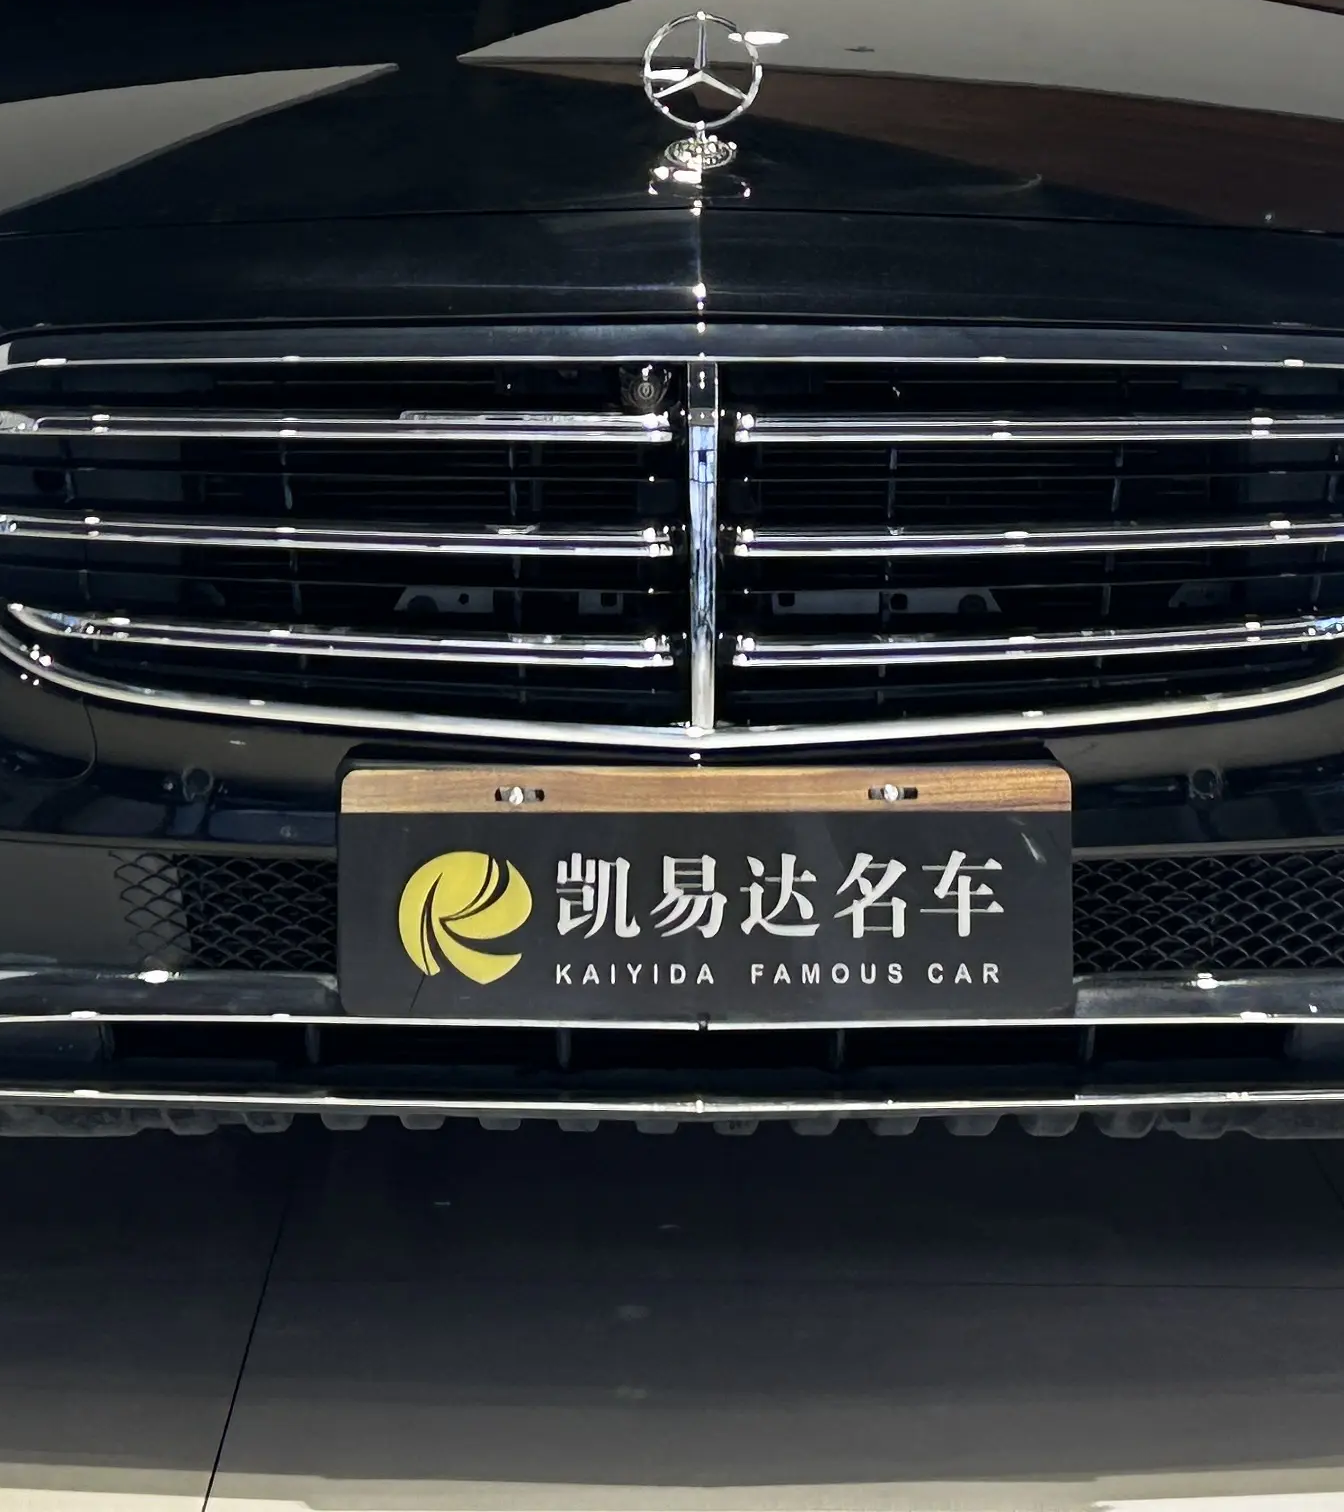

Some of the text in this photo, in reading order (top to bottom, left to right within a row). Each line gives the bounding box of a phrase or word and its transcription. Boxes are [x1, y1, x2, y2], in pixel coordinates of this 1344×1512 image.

[555, 849, 1005, 940] 凯易达名车
[555, 962, 1003, 986] KAIYIDA FAMOUS CAR
